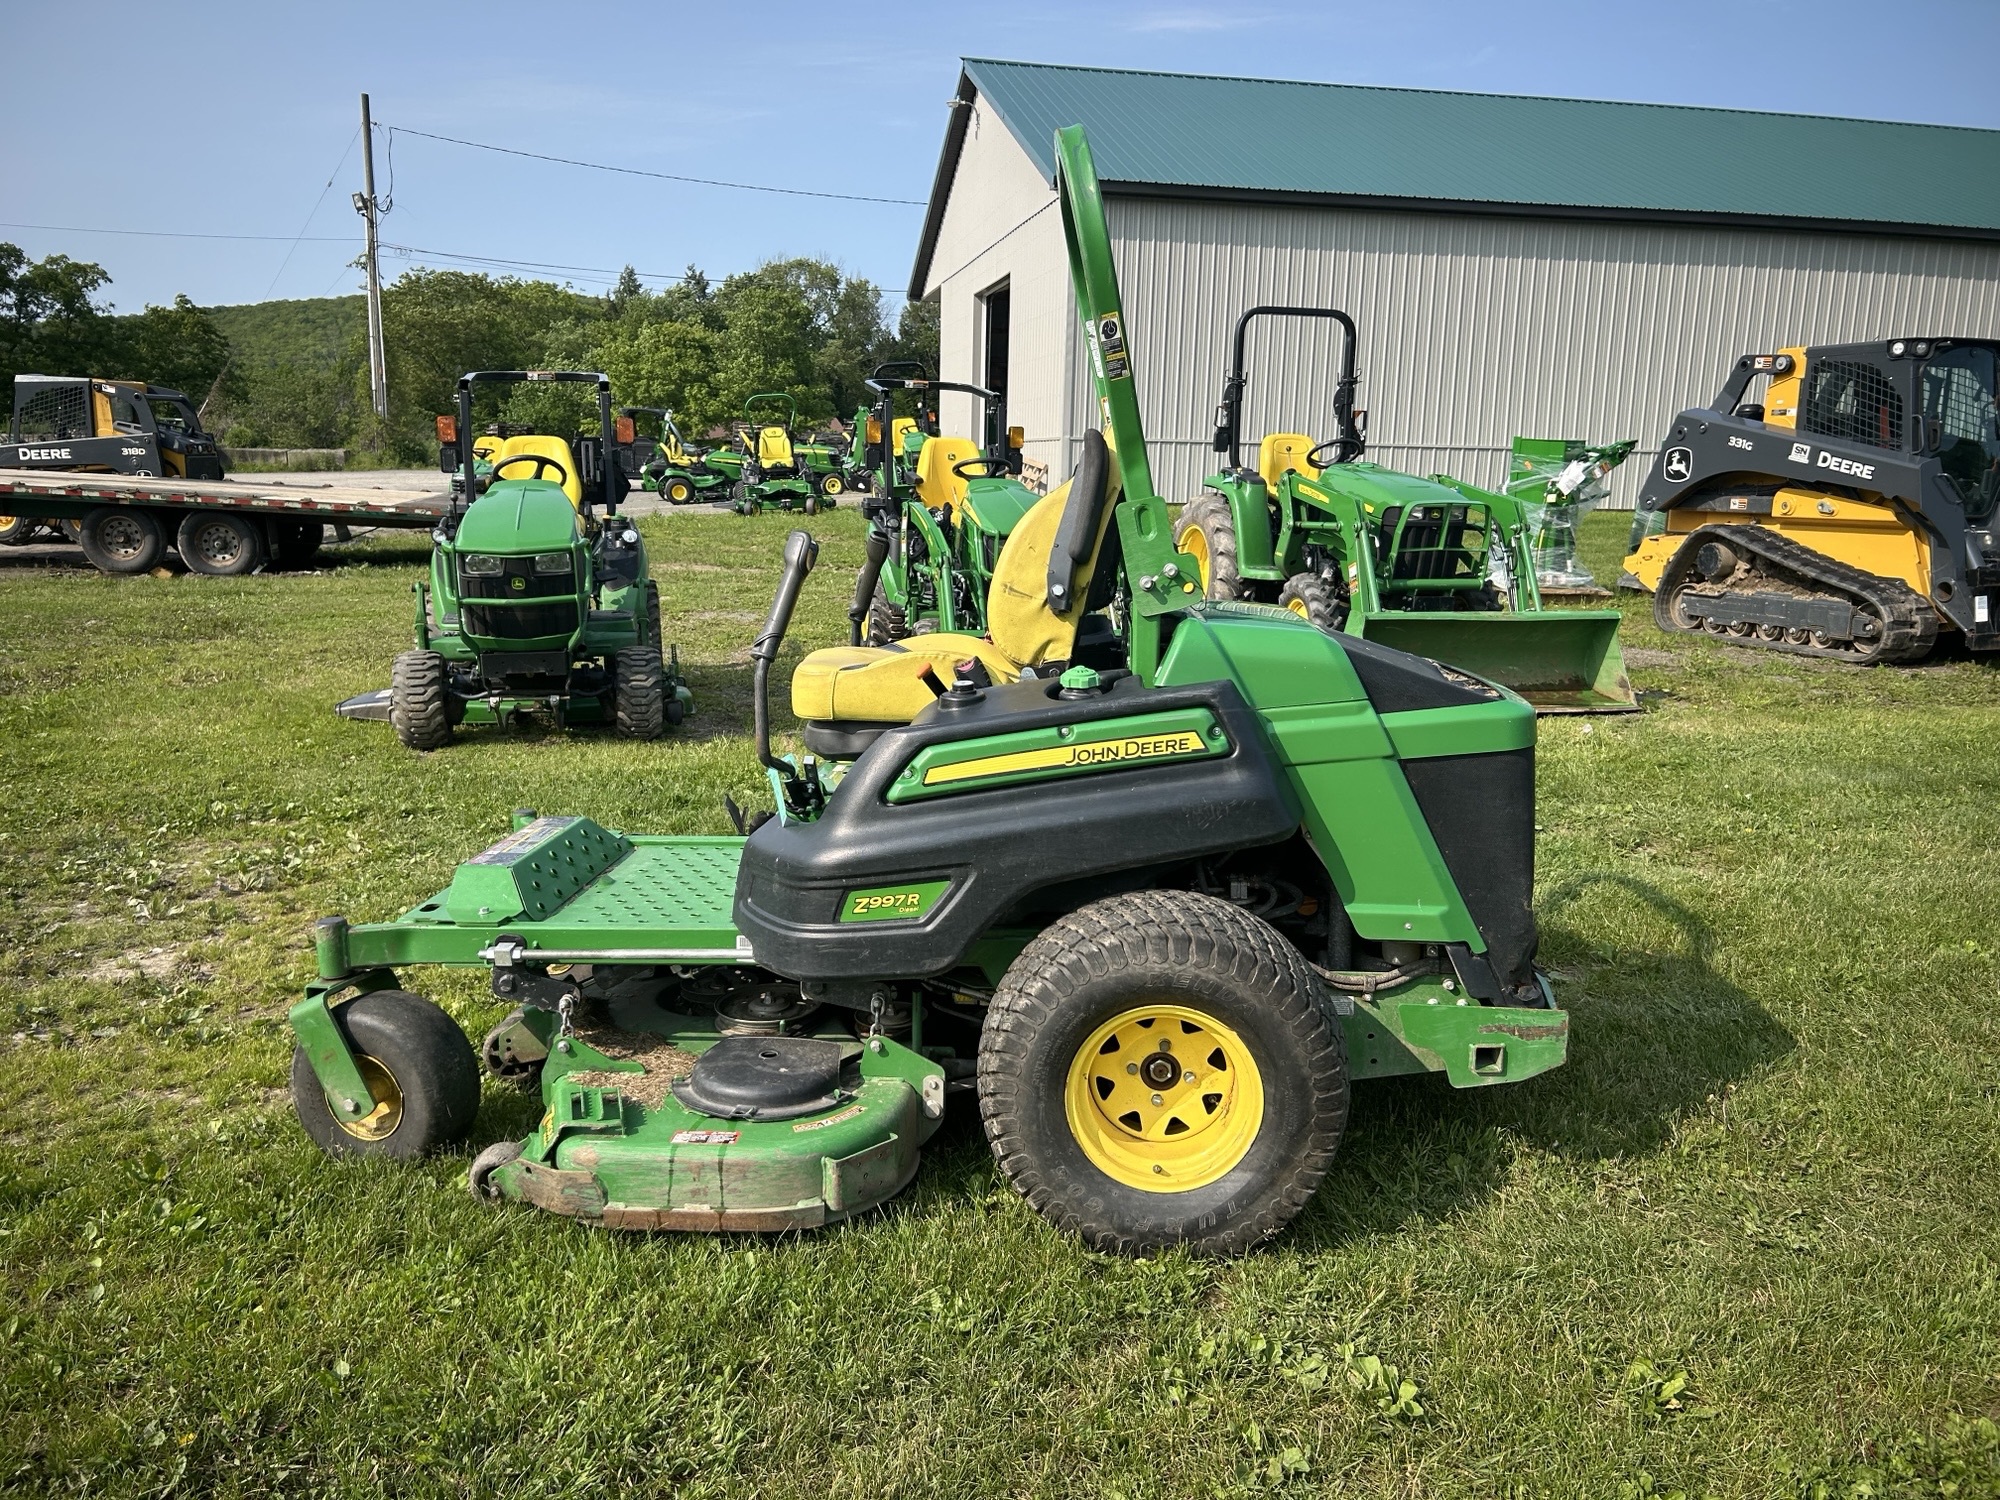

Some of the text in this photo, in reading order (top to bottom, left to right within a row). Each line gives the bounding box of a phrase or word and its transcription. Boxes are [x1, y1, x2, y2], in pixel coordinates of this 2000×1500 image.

[18, 447, 72, 461] DEERE
[121, 447, 146, 456] 318D
[1727, 436, 1754, 451] 331G
[1793, 445, 1808, 456] SN
[1816, 451, 1875, 480] DEERE
[1065, 738, 1190, 764] JOHN DEERE
[852, 893, 921, 915] Z997R
[1145, 972, 1257, 1017] KENDA
[1132, 1199, 1242, 1235] TURF
